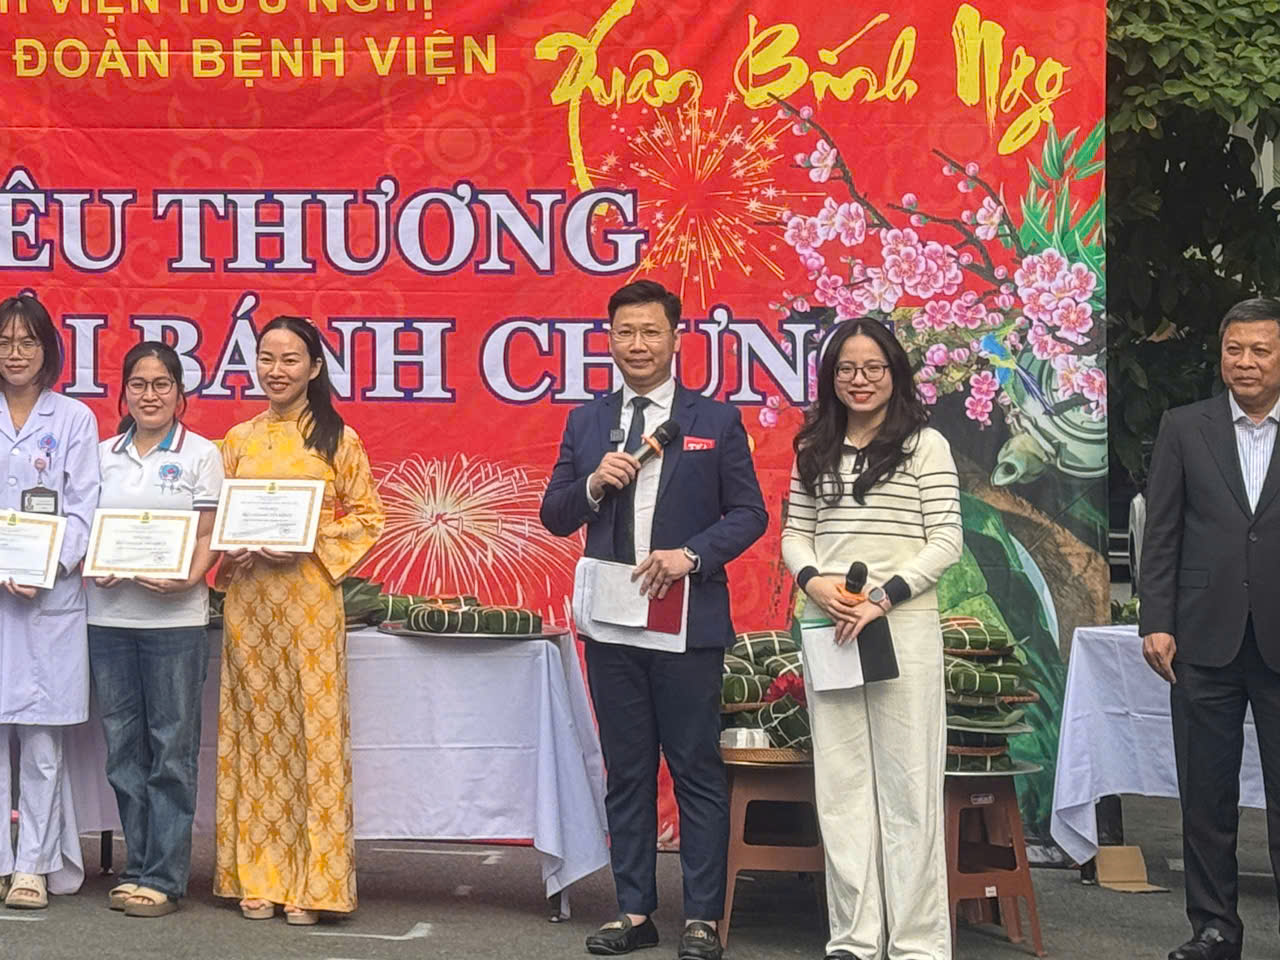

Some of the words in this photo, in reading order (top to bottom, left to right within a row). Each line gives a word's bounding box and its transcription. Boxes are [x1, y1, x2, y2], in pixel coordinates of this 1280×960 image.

[12, 28, 169, 78] ĐOÀN
[192, 31, 346, 88] BỆNH
[365, 29, 497, 85] VIỆN
[733, 13, 918, 110] Bính
[152, 174, 649, 276] THƯƠNG
[479, 304, 895, 407] CHƯN
